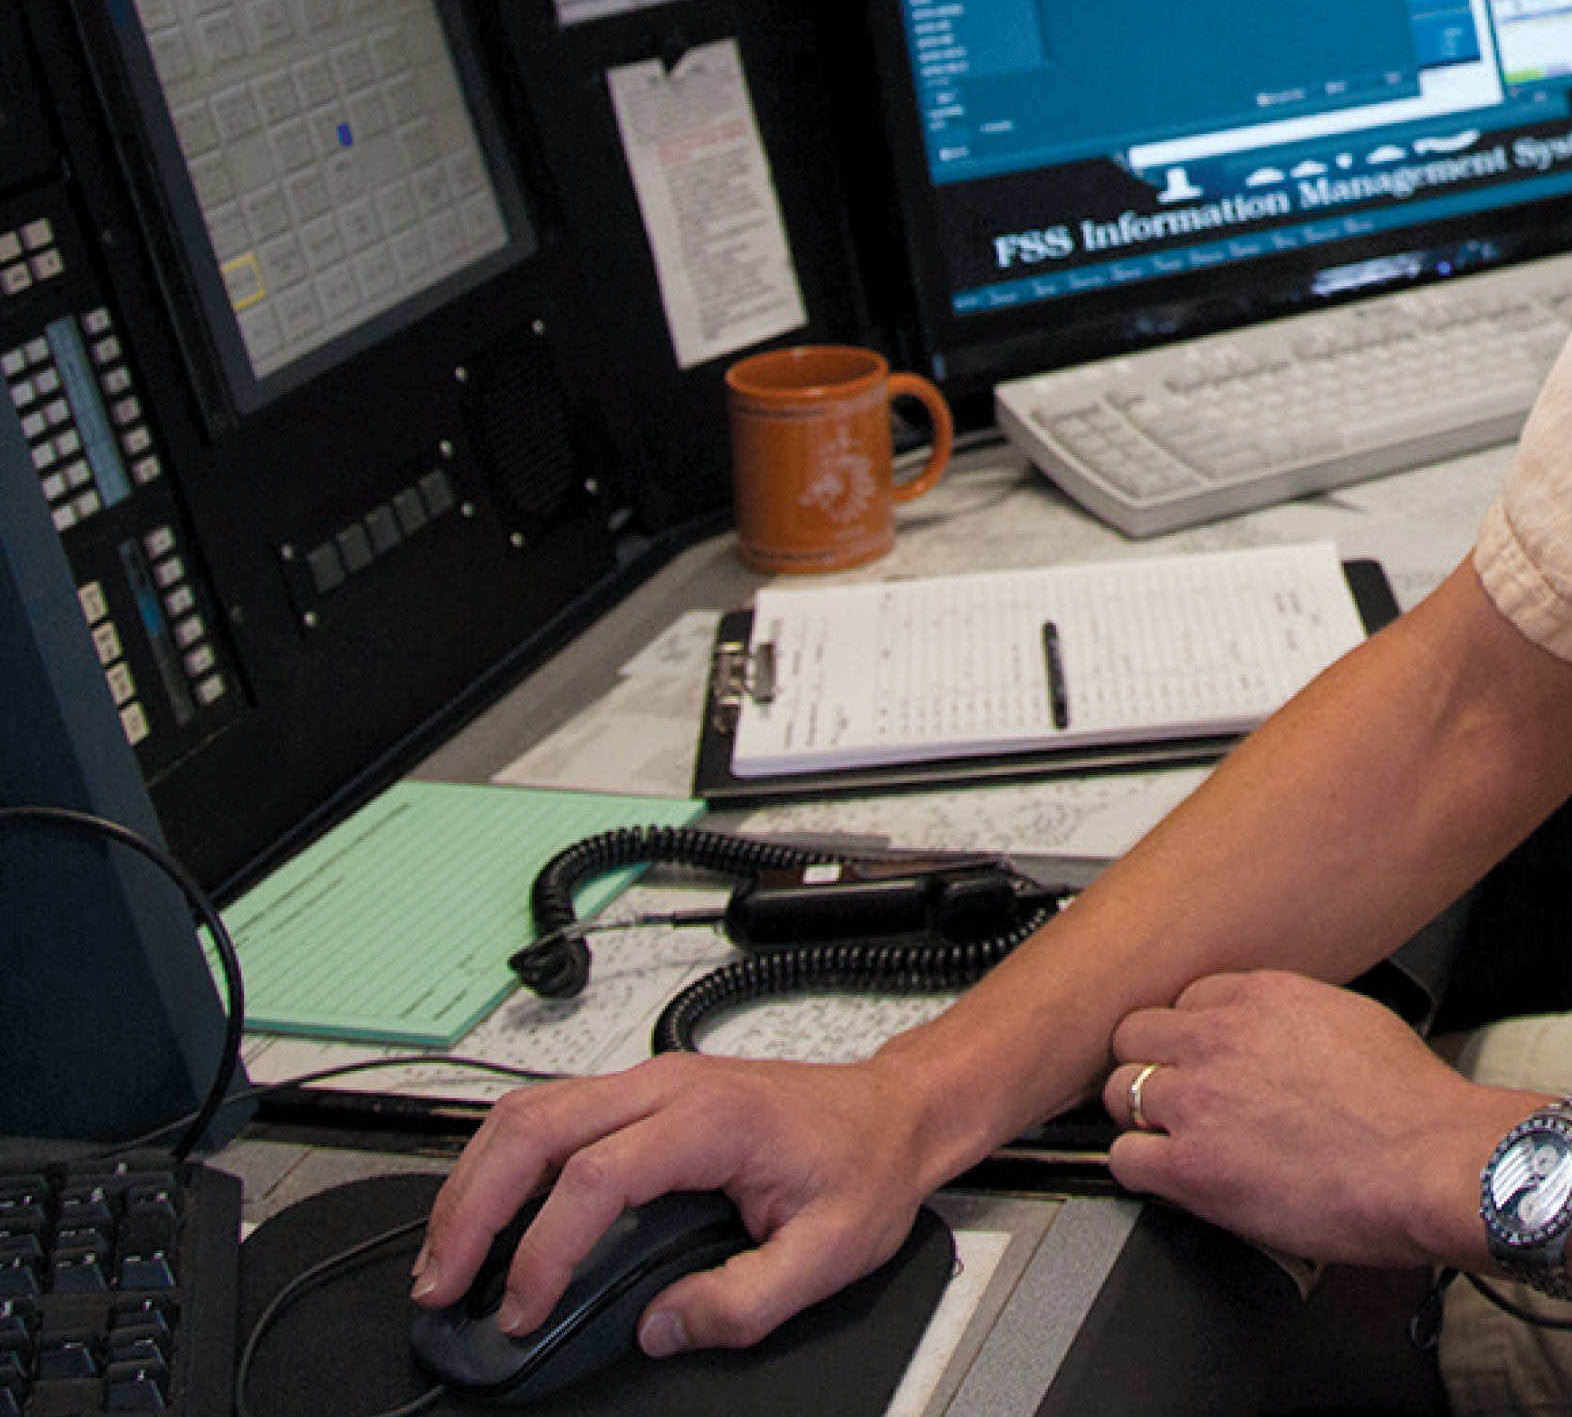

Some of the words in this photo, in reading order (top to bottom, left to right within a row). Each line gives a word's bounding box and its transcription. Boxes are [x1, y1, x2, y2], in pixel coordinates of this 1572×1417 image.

[994, 225, 1074, 268] FSS
[1081, 209, 1290, 251] Information
[1298, 146, 1508, 209] Management
